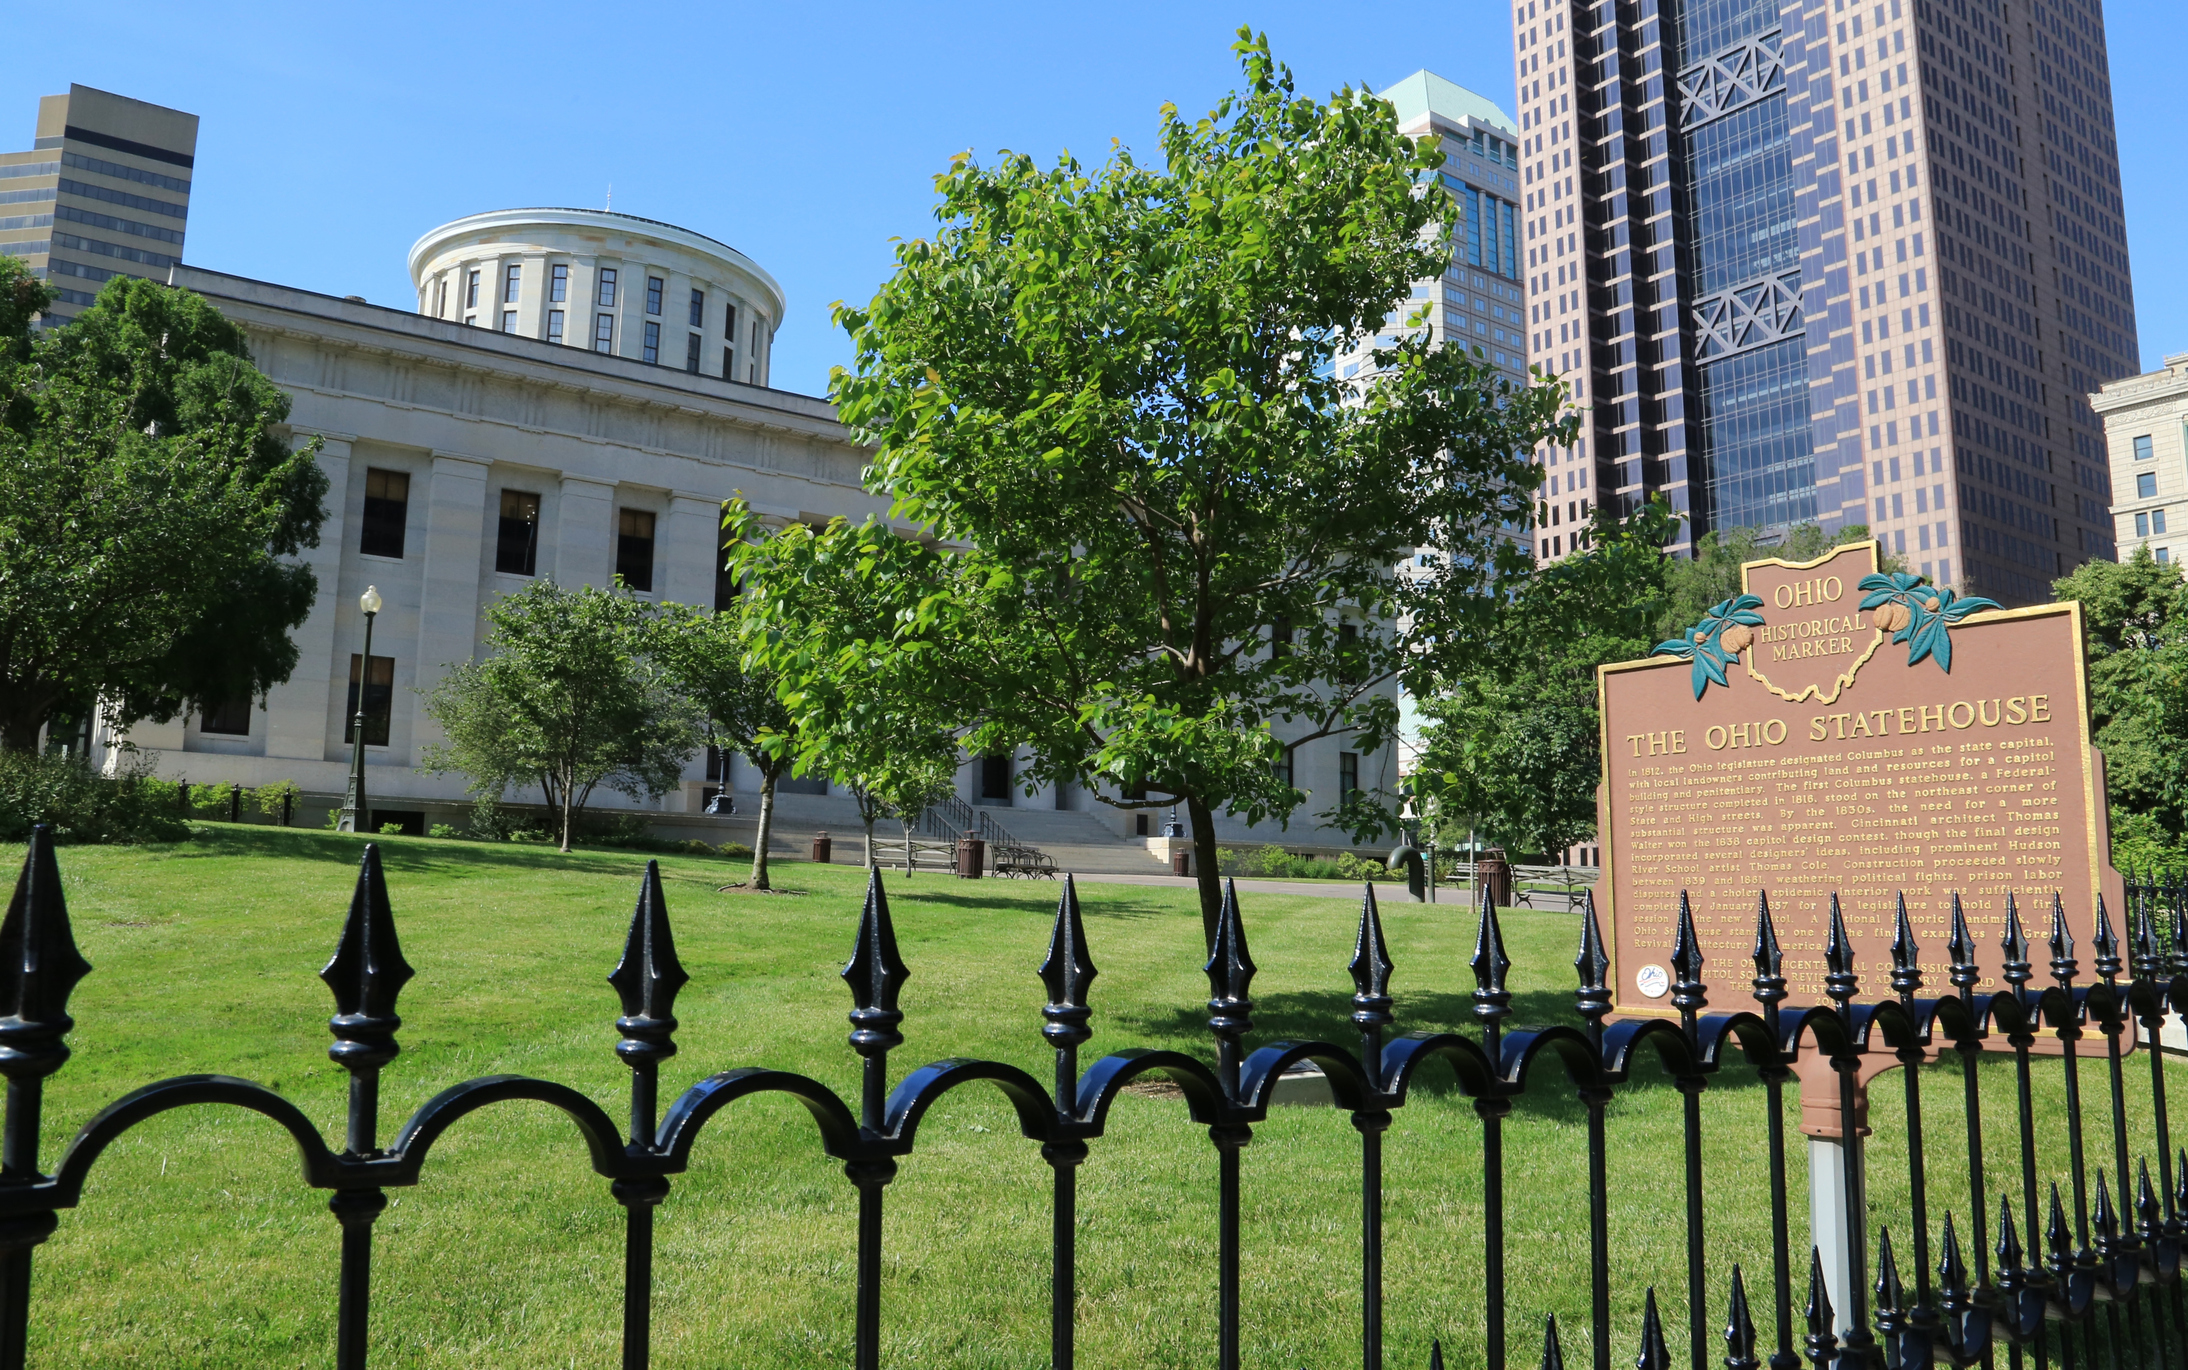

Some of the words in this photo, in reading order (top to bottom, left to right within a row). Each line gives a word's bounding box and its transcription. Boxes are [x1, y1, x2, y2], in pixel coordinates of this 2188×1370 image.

[1774, 576, 1843, 609] OHIO
[1760, 614, 1866, 643] HISTORICAL
[1773, 636, 1853, 662] MARKER
[1626, 730, 1687, 758] THE
[1705, 718, 1788, 750] OHIO
[1809, 694, 2052, 741] STATEHOUSE
[1628, 768, 1638, 777] In
[1668, 765, 1685, 775] the
[1689, 762, 1713, 773] Ohio
[1716, 758, 1776, 772] legislature
[1779, 752, 1843, 766] designated
[1846, 748, 1904, 761] Columbus
[1910, 747, 1925, 756] as
[1930, 744, 1953, 755] the
[1959, 741, 1993, 753] state
[1628, 779, 1650, 789] with
[1653, 777, 1679, 788] local
[1683, 774, 1743, 786] landowners
[1748, 768, 1818, 781] contributing
[1823, 765, 1850, 776] land
[1856, 763, 1879, 774] and
[1886, 759, 1951, 772] resources
[1959, 756, 1981, 767] for
[1987, 756, 1996, 765] a
[2004, 750, 2055, 765] capitol
[1629, 791, 1669, 802] building
[1673, 789, 1692, 799] and
[1696, 785, 1766, 799] penitentiary.
[1775, 782, 1798, 792] The
[1803, 780, 1829, 791] first
[1834, 776, 1893, 789] Columbus
[1980, 771, 1989, 780] a
[1629, 804, 1654, 815] style
[1659, 799, 1708, 812] structure
[1713, 797, 1769, 809] completed
[1774, 796, 1786, 806] in
[1824, 791, 1858, 803] stood
[1864, 792, 1880, 800] on
[1886, 789, 1907, 799] the
[1914, 785, 1979, 798] northeast
[1985, 782, 2034, 794] corner
[2041, 779, 2057, 791] of
[1629, 816, 1656, 826] State
[1663, 815, 1682, 824] and
[1688, 813, 1713, 825] High
[1721, 811, 1764, 821] streets.
[1779, 808, 1795, 819] By
[1805, 807, 1826, 817] the
[1887, 803, 1909, 813] the
[1920, 800, 1952, 811] need
[1964, 799, 1987, 810] for
[1998, 799, 2007, 808] a
[2021, 796, 2058, 807] more
[1630, 827, 1685, 838] substantial
[1693, 822, 1745, 835] structure
[1752, 824, 1773, 832] was
[1780, 821, 1837, 833] apparent.
[1851, 815, 1919, 828] Cincinnati
[1930, 813, 1996, 825] architect
[2005, 811, 2060, 822] Thomas
[1693, 839, 1711, 847] the
[1746, 835, 1787, 846] capitol
[1792, 833, 1832, 846] design
[1894, 829, 1940, 841] though
[1945, 828, 1968, 838] the
[1974, 826, 2007, 838] final
[2014, 825, 2061, 837] design
[1631, 851, 1699, 863] incorporated
[1704, 850, 1743, 860] several
[1859, 844, 1921, 856] including
[1929, 841, 1999, 855] prominent
[2008, 840, 2062, 851] Hudson
[1631, 865, 1659, 874] River
[1665, 863, 1700, 873] School
[1708, 862, 1741, 872] artist
[1748, 862, 1792, 871] Thomas
[1801, 860, 1830, 870] Cole.
[1843, 858, 1925, 869] Construction
[1933, 855, 2006, 869] proceeded
[2015, 853, 2062, 866] slowly
[1632, 877, 1675, 886] between
[1714, 876, 1733, 885] and
[1775, 873, 1843, 885] weathering
[1851, 872, 1907, 885] political
[1968, 870, 2013, 883] prison
[2023, 869, 2063, 880] labor
[1689, 889, 1702, 898] nd
[1709, 890, 1716, 898] a
[1722, 888, 1761, 897] choler
[1771, 887, 1827, 898] epidemic.
[1839, 886, 1889, 896] Interior
[1633, 902, 1681, 913] complete
[1709, 902, 1755, 912] January
[1767, 901, 1789, 910] 857
[1799, 901, 1817, 910] for
[1857, 900, 1928, 912] legislaure
[1938, 901, 1951, 910] to
[1962, 900, 1992, 910] hold
[2003, 900, 2020, 909] is
[2033, 899, 2065, 909] firt
[1633, 914, 1669, 923] session
[1695, 914, 1712, 923] the
[1720, 915, 1742, 923] new
[1811, 914, 1819, 923] A
[1633, 926, 1657, 935] Ohio
[1634, 939, 1673, 948] Revival
[1782, 941, 1826, 951] merica.
[1641, 967, 1664, 981] Ohio
[1711, 958, 1733, 968] THE
[1729, 981, 1752, 992] THE
[1791, 972, 1829, 982] REVIE
